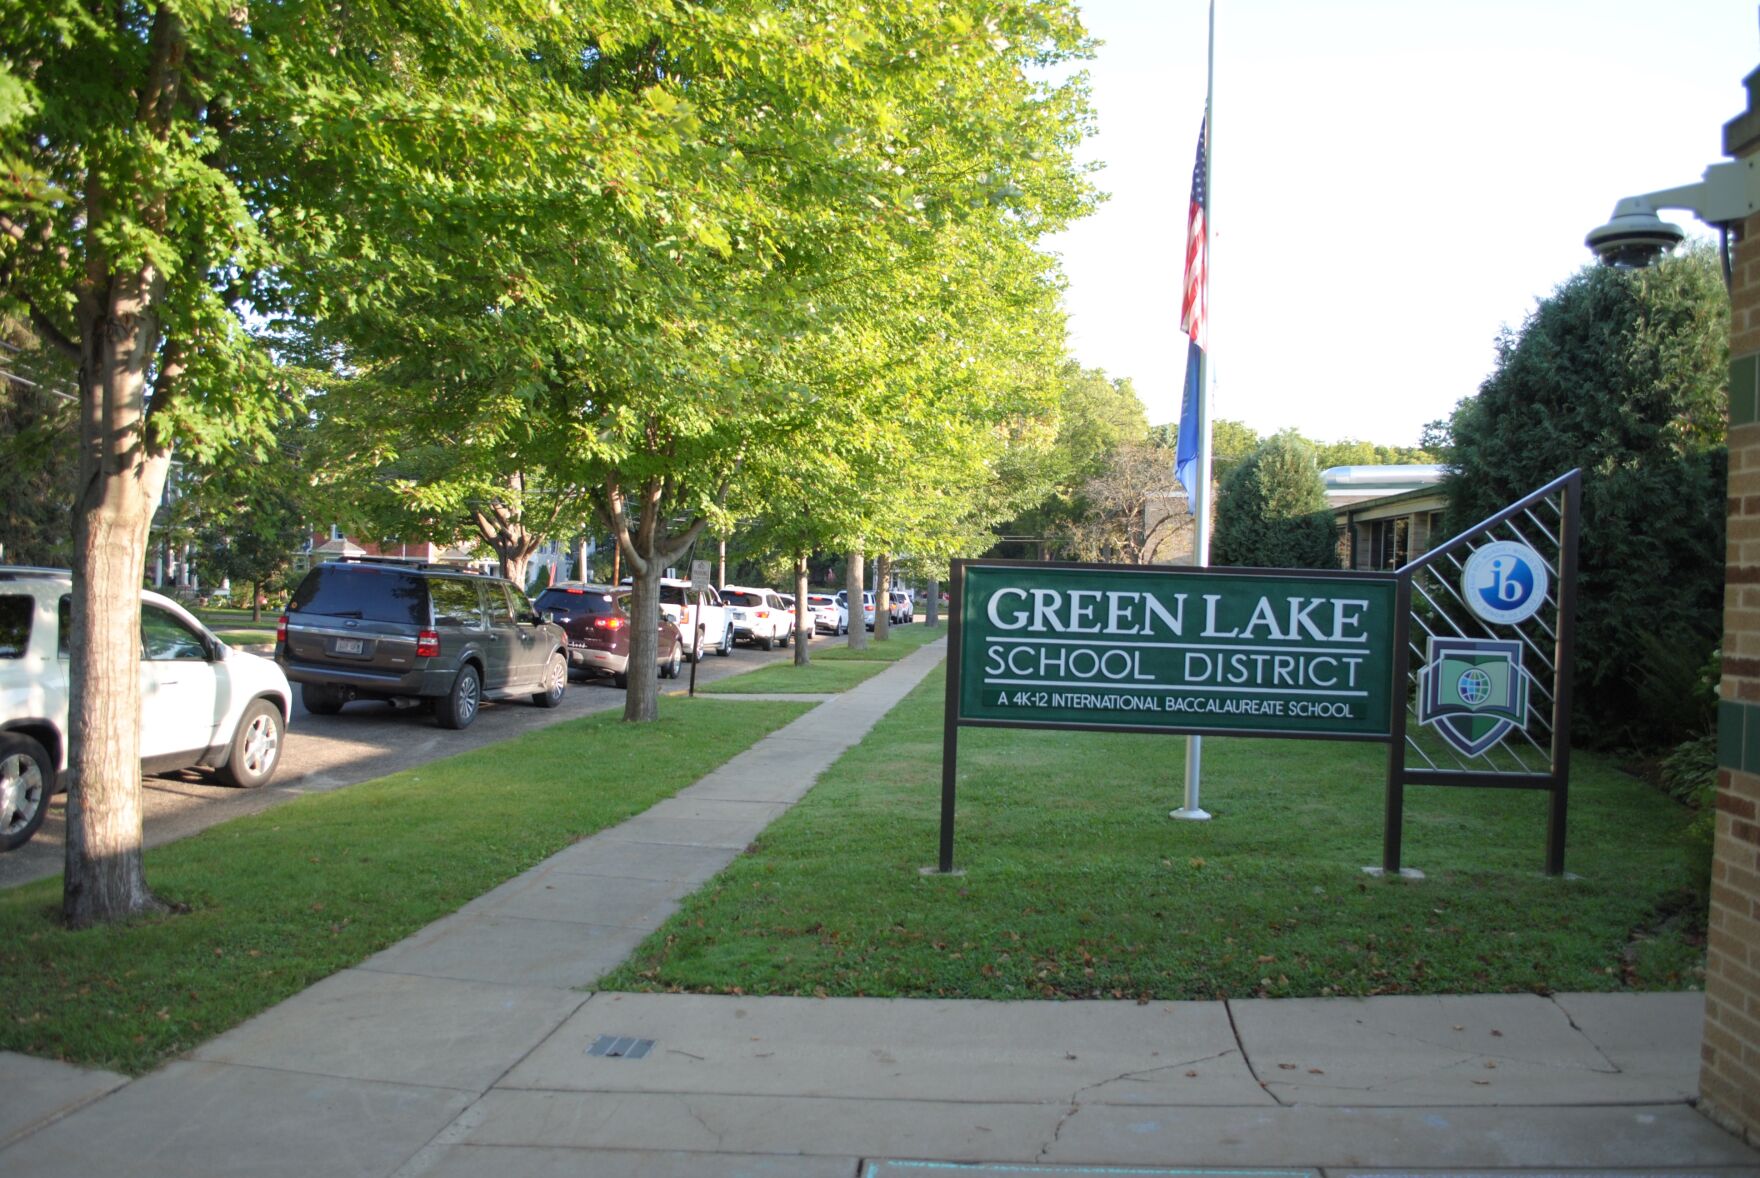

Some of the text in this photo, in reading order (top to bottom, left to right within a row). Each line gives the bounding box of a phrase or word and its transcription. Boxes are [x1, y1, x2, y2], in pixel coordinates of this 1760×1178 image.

[1490, 559, 1523, 602] ib
[987, 587, 1369, 642] GREEN LAKE
[985, 645, 1363, 687] SCHOOL DISTRICT
[997, 691, 1354, 718] A 4K-12 INTERNATIONAL BACCALAUREATE SCHOOL
